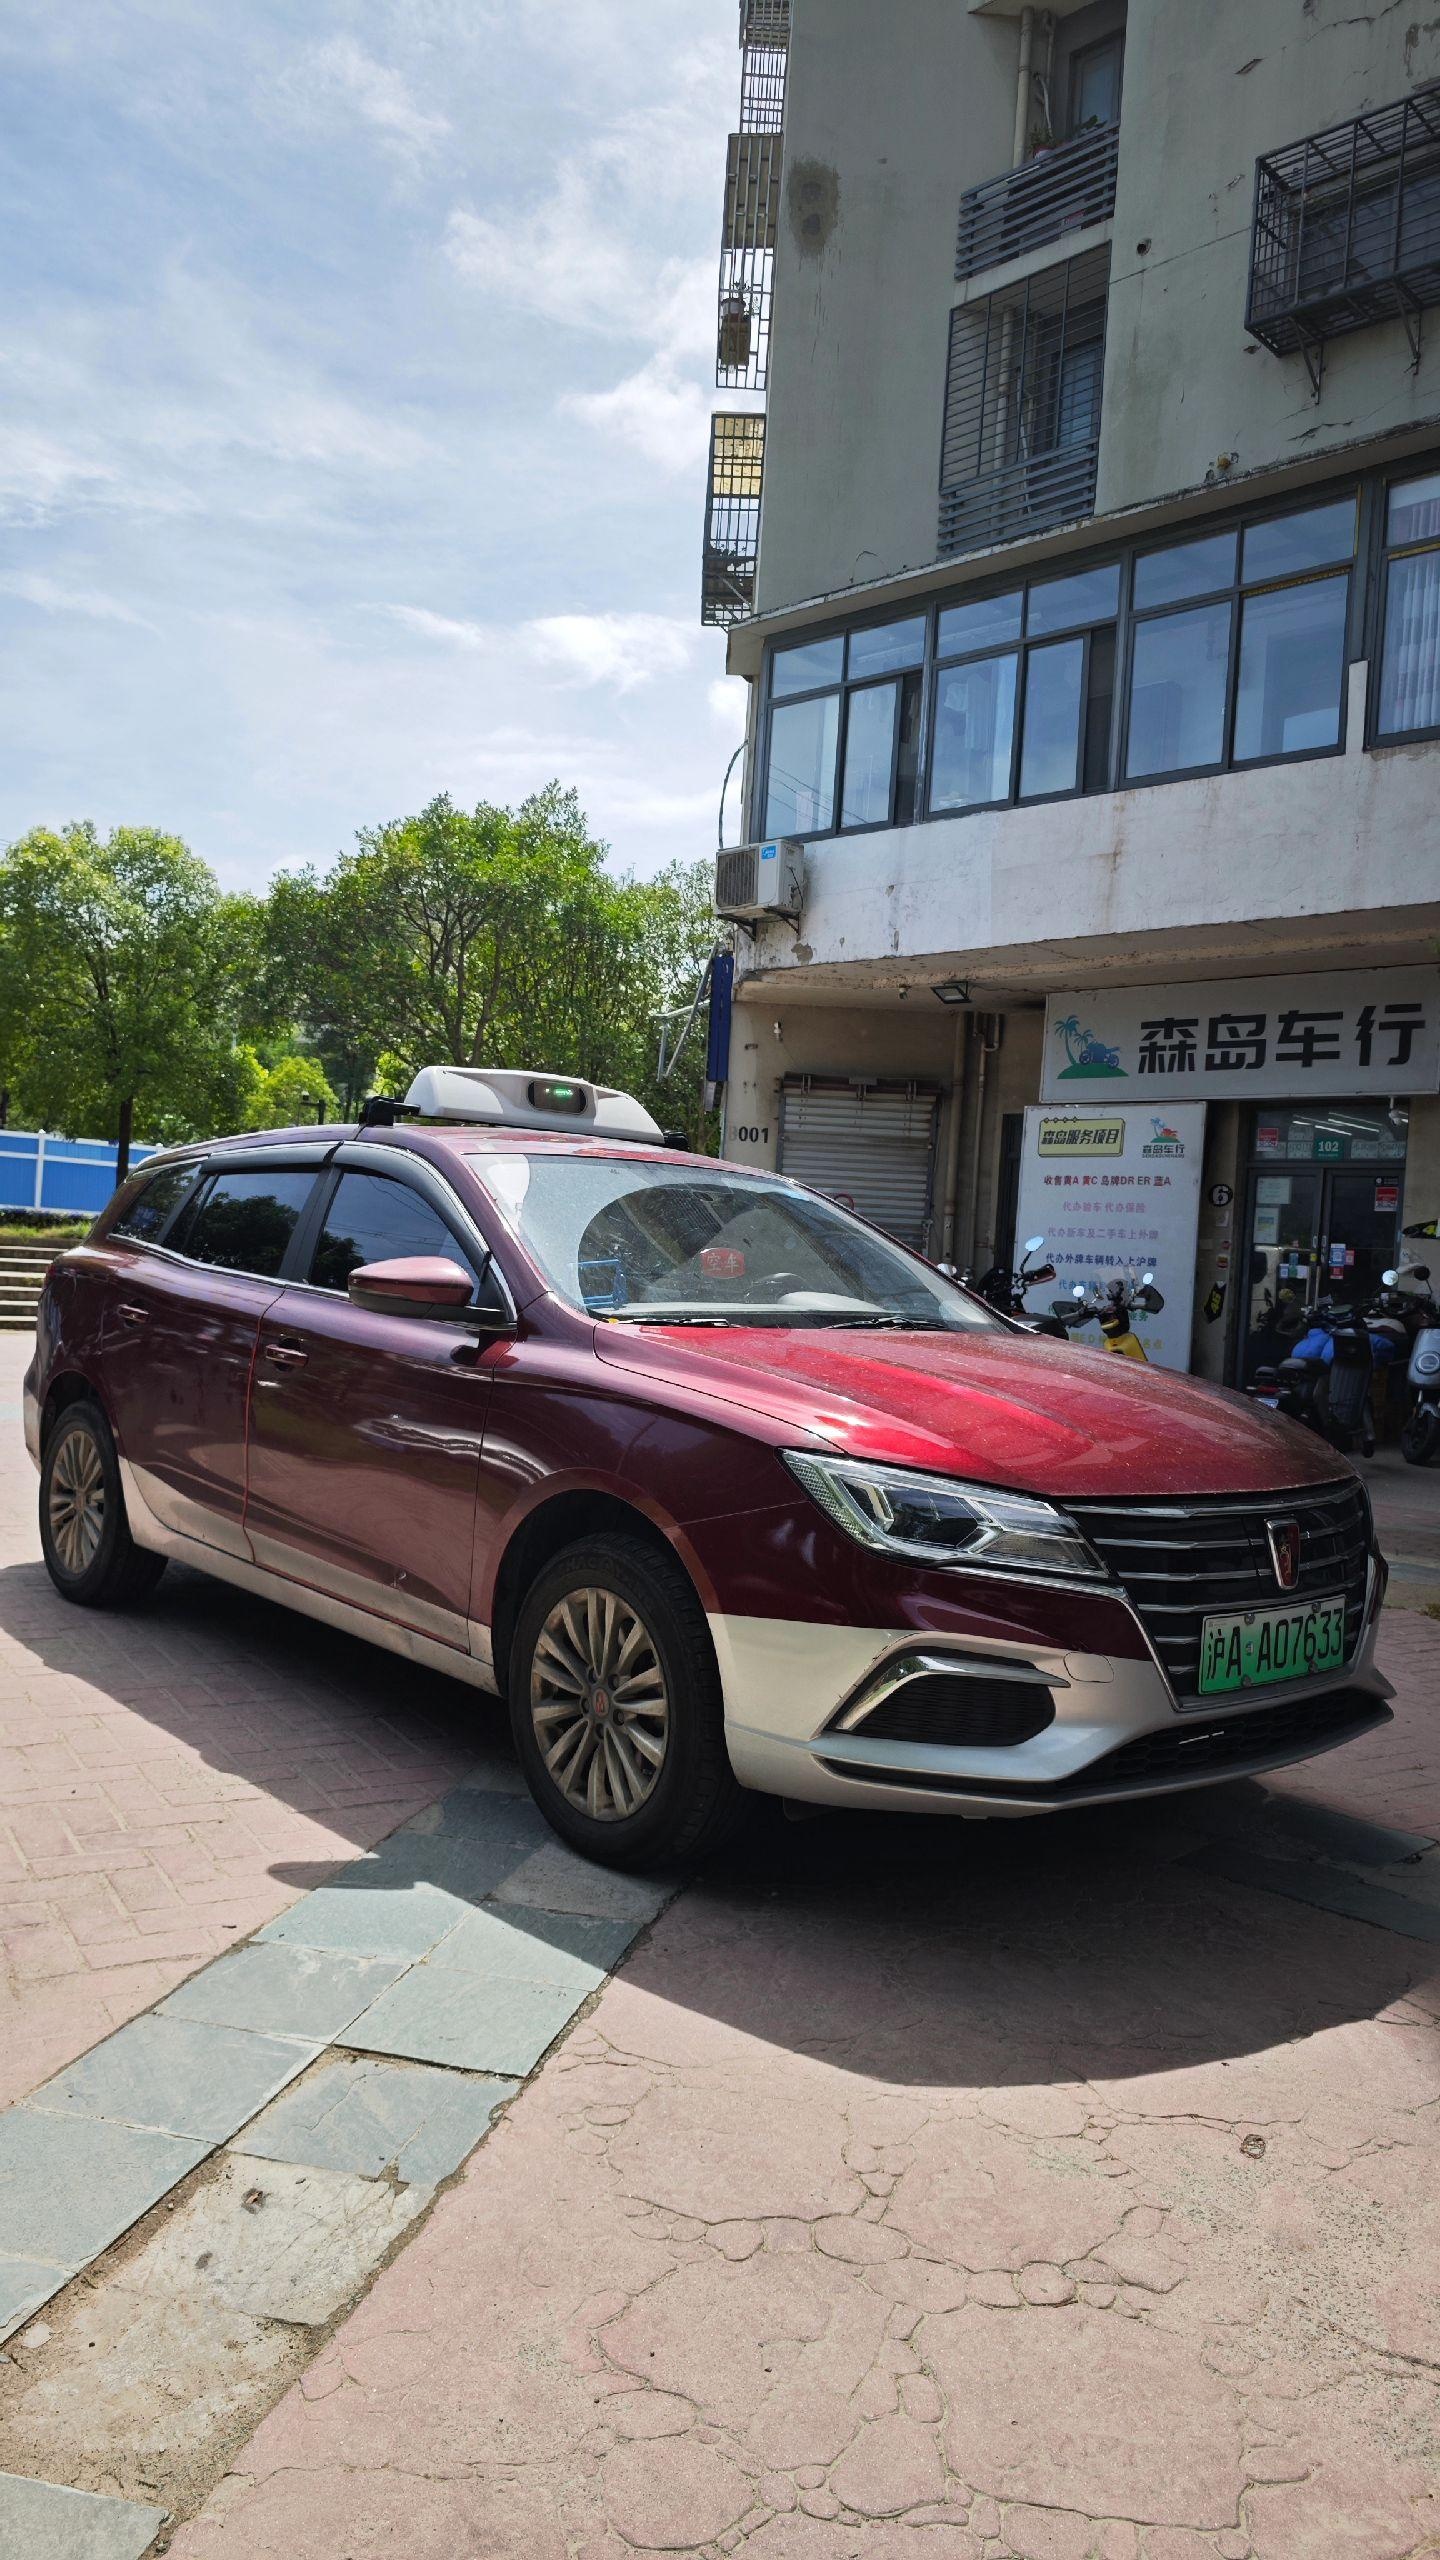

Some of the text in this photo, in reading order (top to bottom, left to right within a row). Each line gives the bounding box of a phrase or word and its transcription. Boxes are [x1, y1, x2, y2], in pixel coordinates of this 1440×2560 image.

[1138, 1004, 1425, 1075] 森岛车行
[1041, 1128, 1120, 1145] 森岛服务项目
[1142, 1144, 1185, 1154] 森岛车行
[1318, 1141, 1339, 1152] 102
[706, 1252, 740, 1274] 空车
